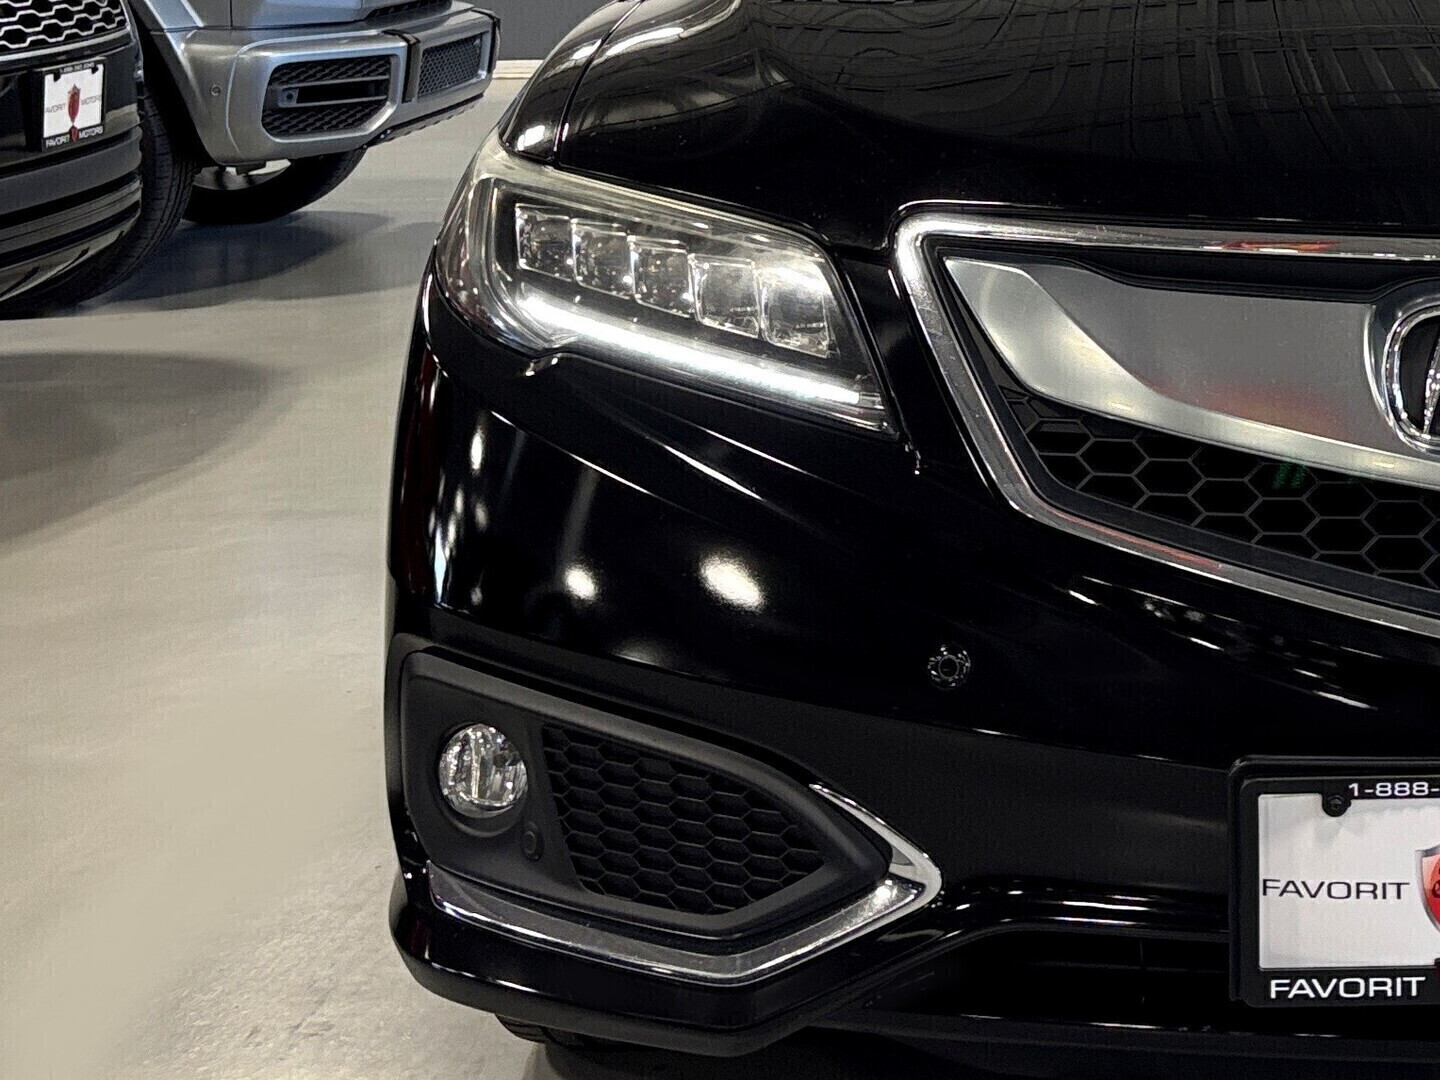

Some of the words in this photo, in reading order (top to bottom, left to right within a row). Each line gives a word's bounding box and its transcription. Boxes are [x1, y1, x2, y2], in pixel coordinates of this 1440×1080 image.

[46, 103, 67, 114] AVORIT
[1262, 878, 1410, 901] FAVORIT
[1269, 975, 1426, 999] FAVORIT
